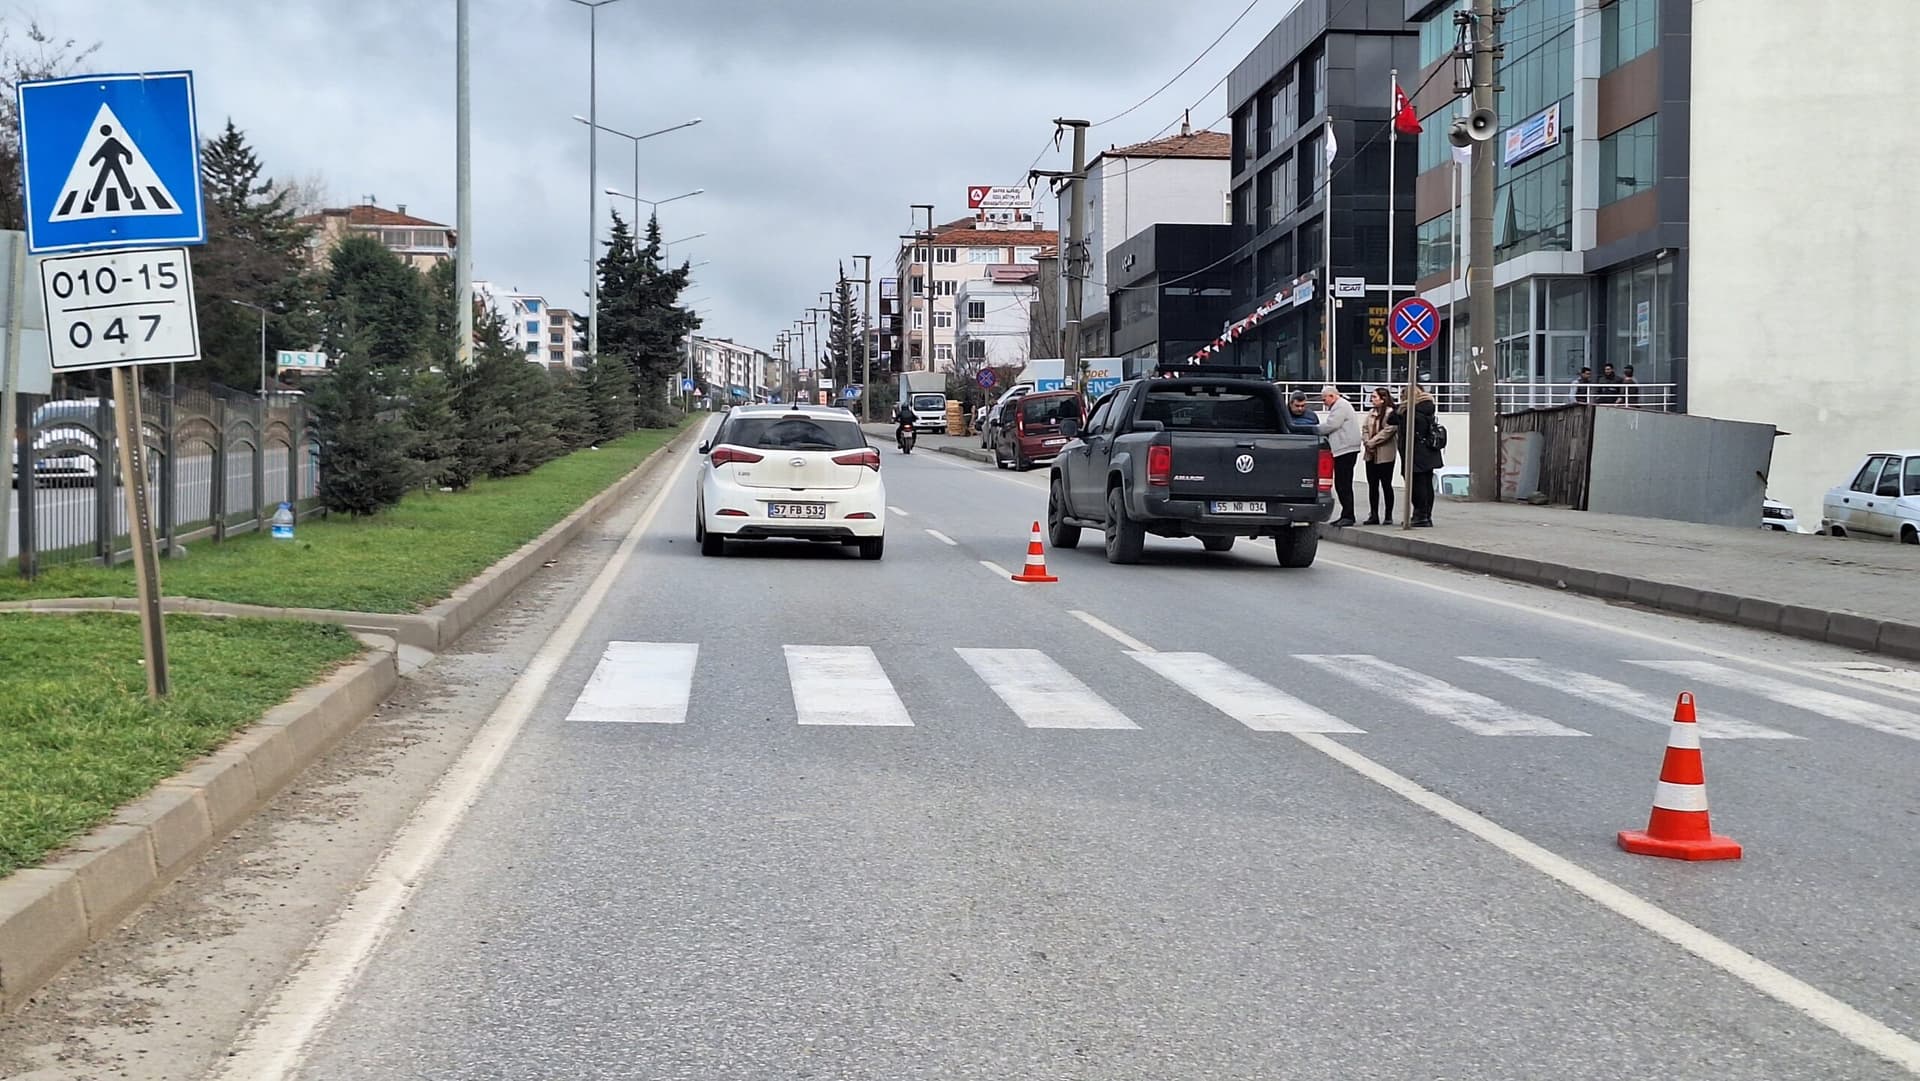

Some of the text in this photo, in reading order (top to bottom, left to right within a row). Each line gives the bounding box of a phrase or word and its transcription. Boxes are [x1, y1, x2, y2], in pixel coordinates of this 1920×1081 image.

[52, 262, 178, 298] 010-15
[774, 504, 824, 516] 57 FB 532
[1217, 502, 1265, 512] 55 NR 034
